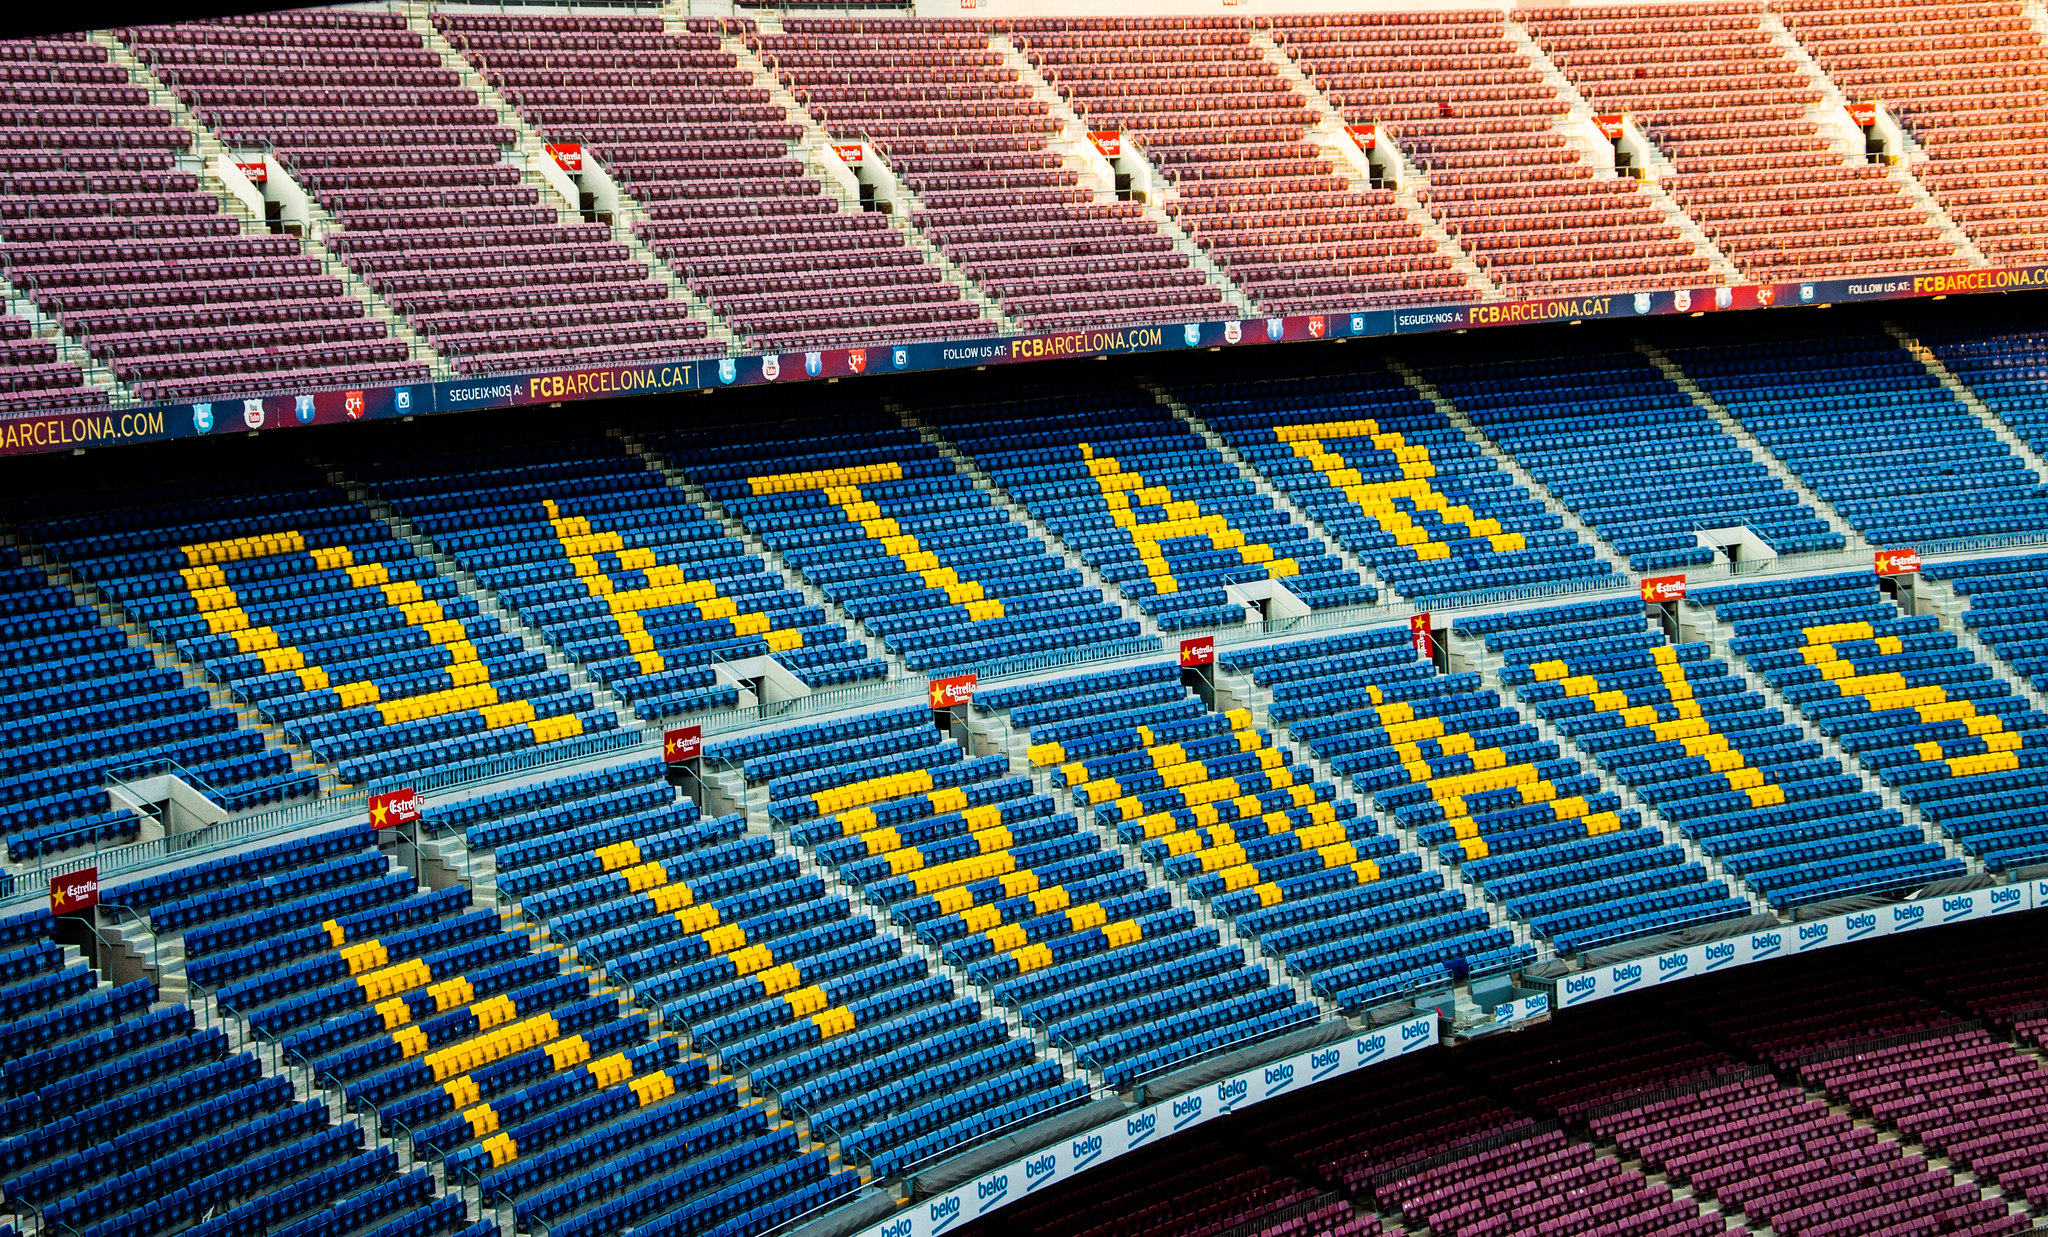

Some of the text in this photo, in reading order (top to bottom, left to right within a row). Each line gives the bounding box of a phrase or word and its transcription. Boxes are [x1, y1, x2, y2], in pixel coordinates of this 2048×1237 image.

[1848, 283, 1883, 295] FOLLOW
[1884, 282, 1896, 292] US
[1897, 281, 1911, 291] AT:
[1399, 297, 1612, 326] SEGUEIX-NOS A: FCBARCELONA.CAT
[943, 327, 1163, 361] FOLLOW US AT: FCBARCELONA.COM
[449, 365, 692, 402] SEGUEIX-NOS A: FCBARCELONA.CAT
[1890, 553, 1922, 566] Estrella
[180, 418, 1526, 743] QATAR
[1656, 579, 1686, 594] Estrella
[1191, 644, 1214, 656] Estrella
[944, 681, 978, 698] Estrella
[675, 734, 700, 749] Estrella
[388, 794, 425, 815] Estrella
[66, 880, 98, 898] Estrella
[322, 620, 2022, 1167] AIRWAYS
[1991, 887, 2021, 904] beko
[1943, 896, 1973, 912] beko
[1846, 913, 1876, 931] beko
[1894, 905, 1924, 922] beko
[1752, 932, 1781, 950] beko
[1799, 923, 1828, 941] beko
[1706, 943, 1735, 960] beko
[1659, 953, 1688, 971] beko
[1613, 964, 1642, 982] beko
[1567, 976, 1596, 994] beko
[1525, 995, 1547, 1010] beko
[1402, 1021, 1430, 1040] beko
[1357, 1035, 1386, 1055] beko
[1311, 1049, 1340, 1070] beko
[1265, 1064, 1294, 1084] beko
[1218, 1079, 1247, 1101] beko
[1173, 1096, 1202, 1118] beko
[1127, 1114, 1155, 1136] beko
[1073, 1136, 1102, 1159] beko
[1026, 1155, 1056, 1178] beko
[978, 1175, 1008, 1200] beko
[931, 1196, 960, 1221] beko
[881, 1219, 912, 1237] beko
